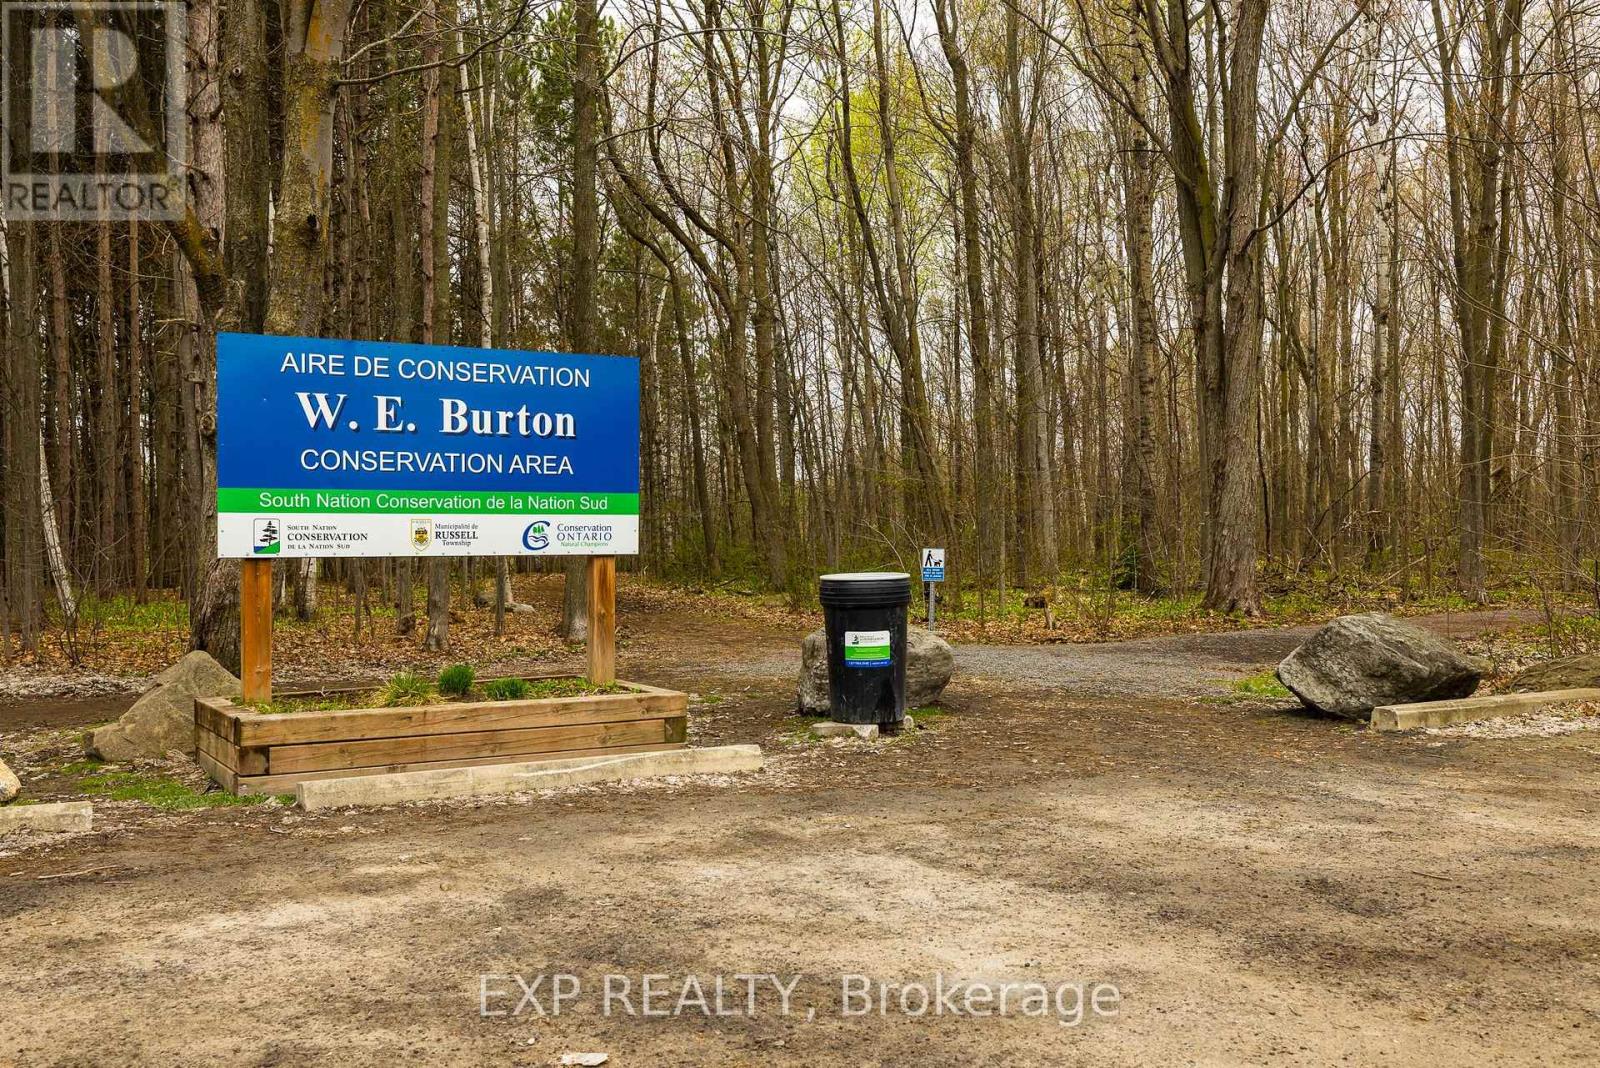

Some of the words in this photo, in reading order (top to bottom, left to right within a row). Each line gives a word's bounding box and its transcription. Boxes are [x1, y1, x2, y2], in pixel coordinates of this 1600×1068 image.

[280, 352, 346, 376] AIRE
[354, 356, 390, 378] DE
[398, 358, 590, 388] CONSERVATION
[295, 392, 359, 431] W.
[373, 395, 416, 433] E.
[439, 398, 577, 438] Burton
[301, 449, 502, 474] CONSERVATION
[508, 454, 574, 475] AREA
[259, 492, 310, 508] South
[317, 493, 370, 508] Nation
[376, 493, 481, 509] Conservation
[486, 496, 505, 509] de
[510, 496, 522, 509] la
[528, 496, 574, 510] Nation
[579, 496, 608, 510] Sud
[557, 523, 612, 532] Conservation
[287, 533, 368, 541] CONSERVATION
[435, 531, 478, 540] RUSSELL
[556, 532, 612, 541] ONTARIO
